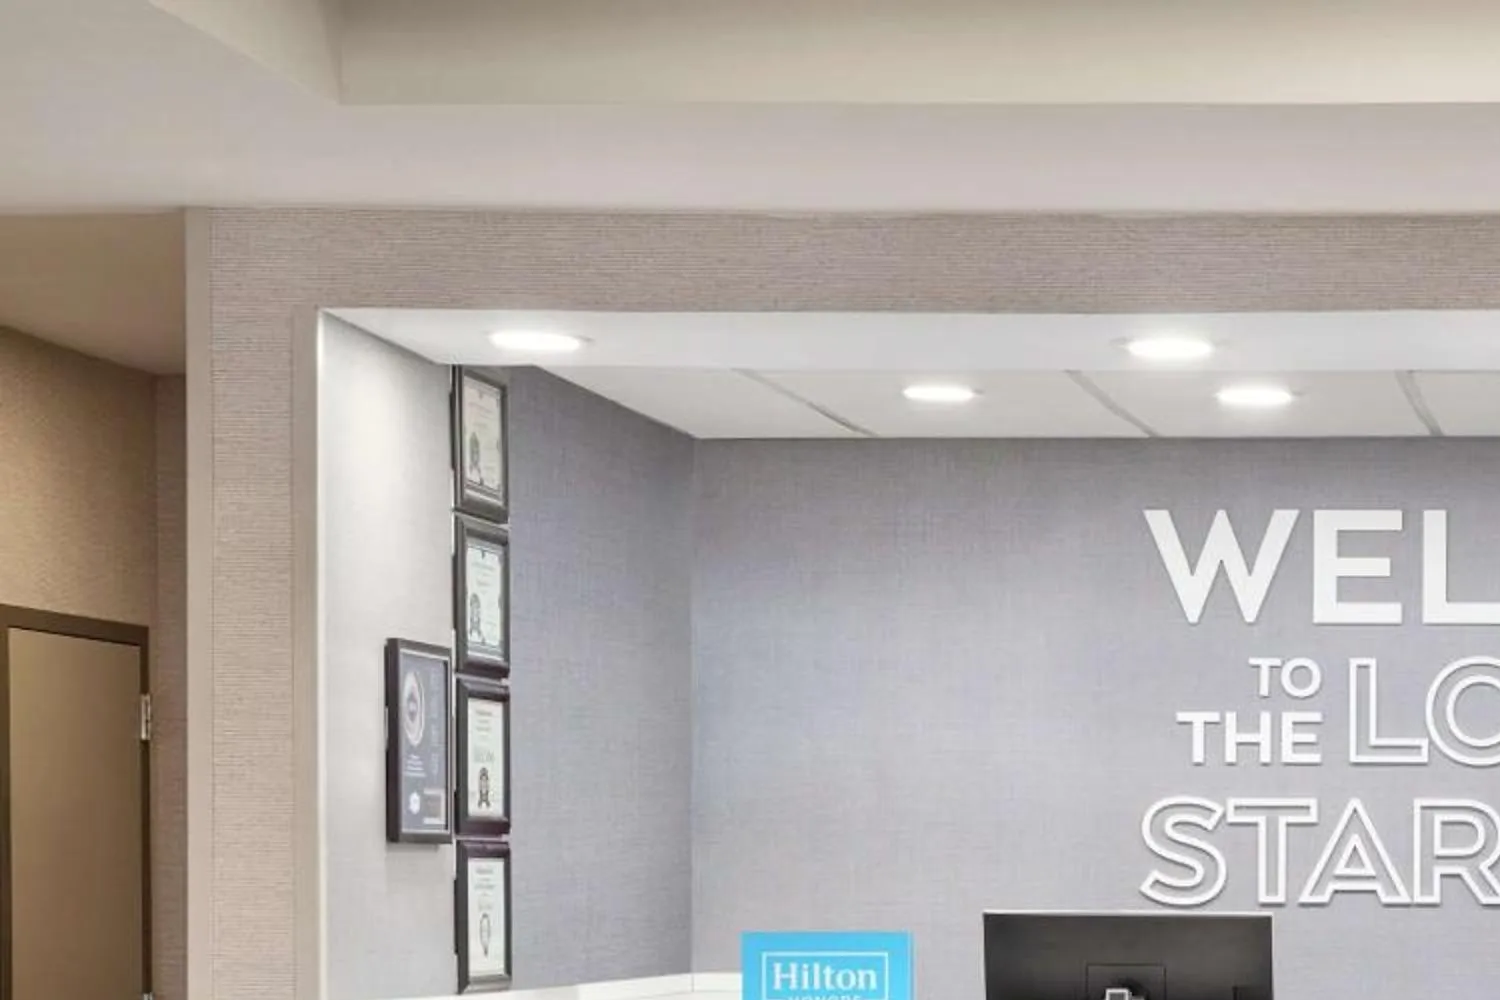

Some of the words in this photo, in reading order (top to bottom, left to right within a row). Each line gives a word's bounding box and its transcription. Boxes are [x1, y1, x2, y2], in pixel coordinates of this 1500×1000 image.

[1249, 658, 1322, 698] TO
[1176, 712, 1323, 765] THE
[773, 962, 877, 990] Hilton
